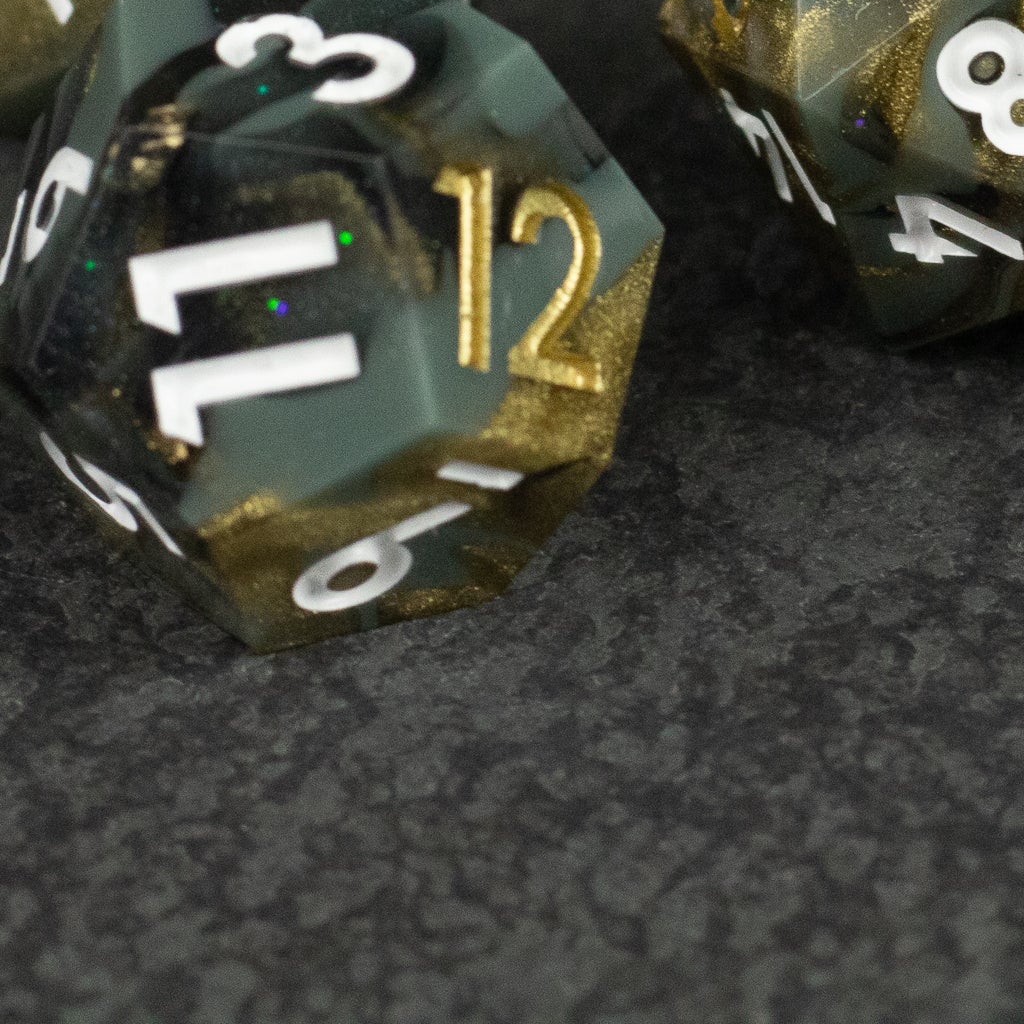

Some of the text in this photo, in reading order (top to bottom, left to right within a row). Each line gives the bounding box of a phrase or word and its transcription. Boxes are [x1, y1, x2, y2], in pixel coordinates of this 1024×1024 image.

[215, 14, 416, 104] 3
[128, 221, 361, 447] 11
[433, 165, 605, 394] 12
